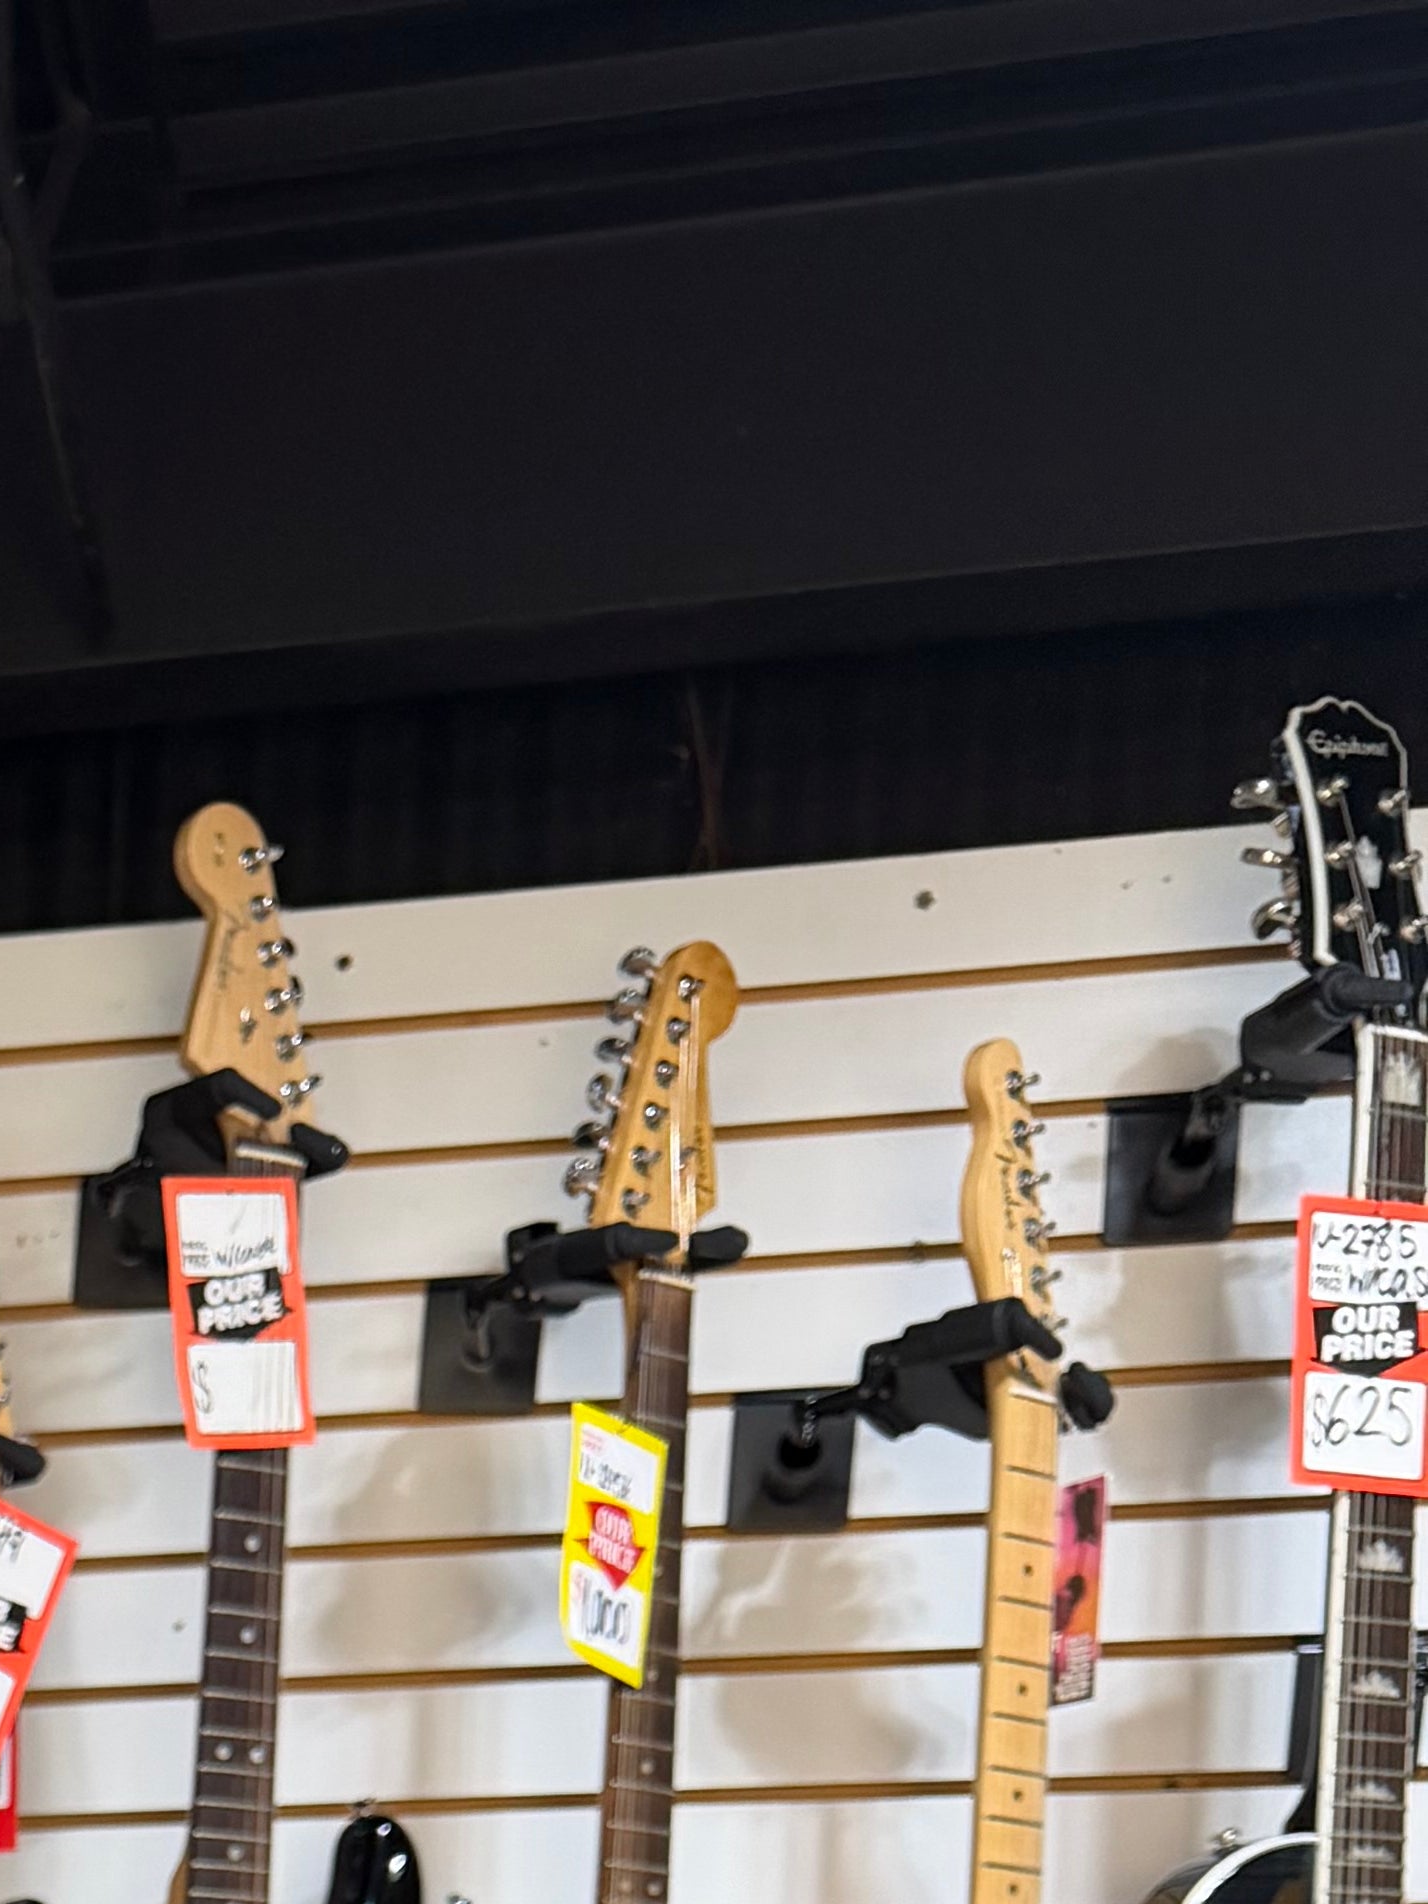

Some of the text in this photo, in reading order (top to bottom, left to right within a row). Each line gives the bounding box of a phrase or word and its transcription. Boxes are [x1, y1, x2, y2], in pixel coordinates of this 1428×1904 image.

[204, 1272, 266, 1306] OUR
[197, 1293, 283, 1335] PRICE
[1331, 1305, 1400, 1334] OUR
[1320, 1330, 1415, 1362] PRICE
[1312, 1384, 1413, 1448] $625
